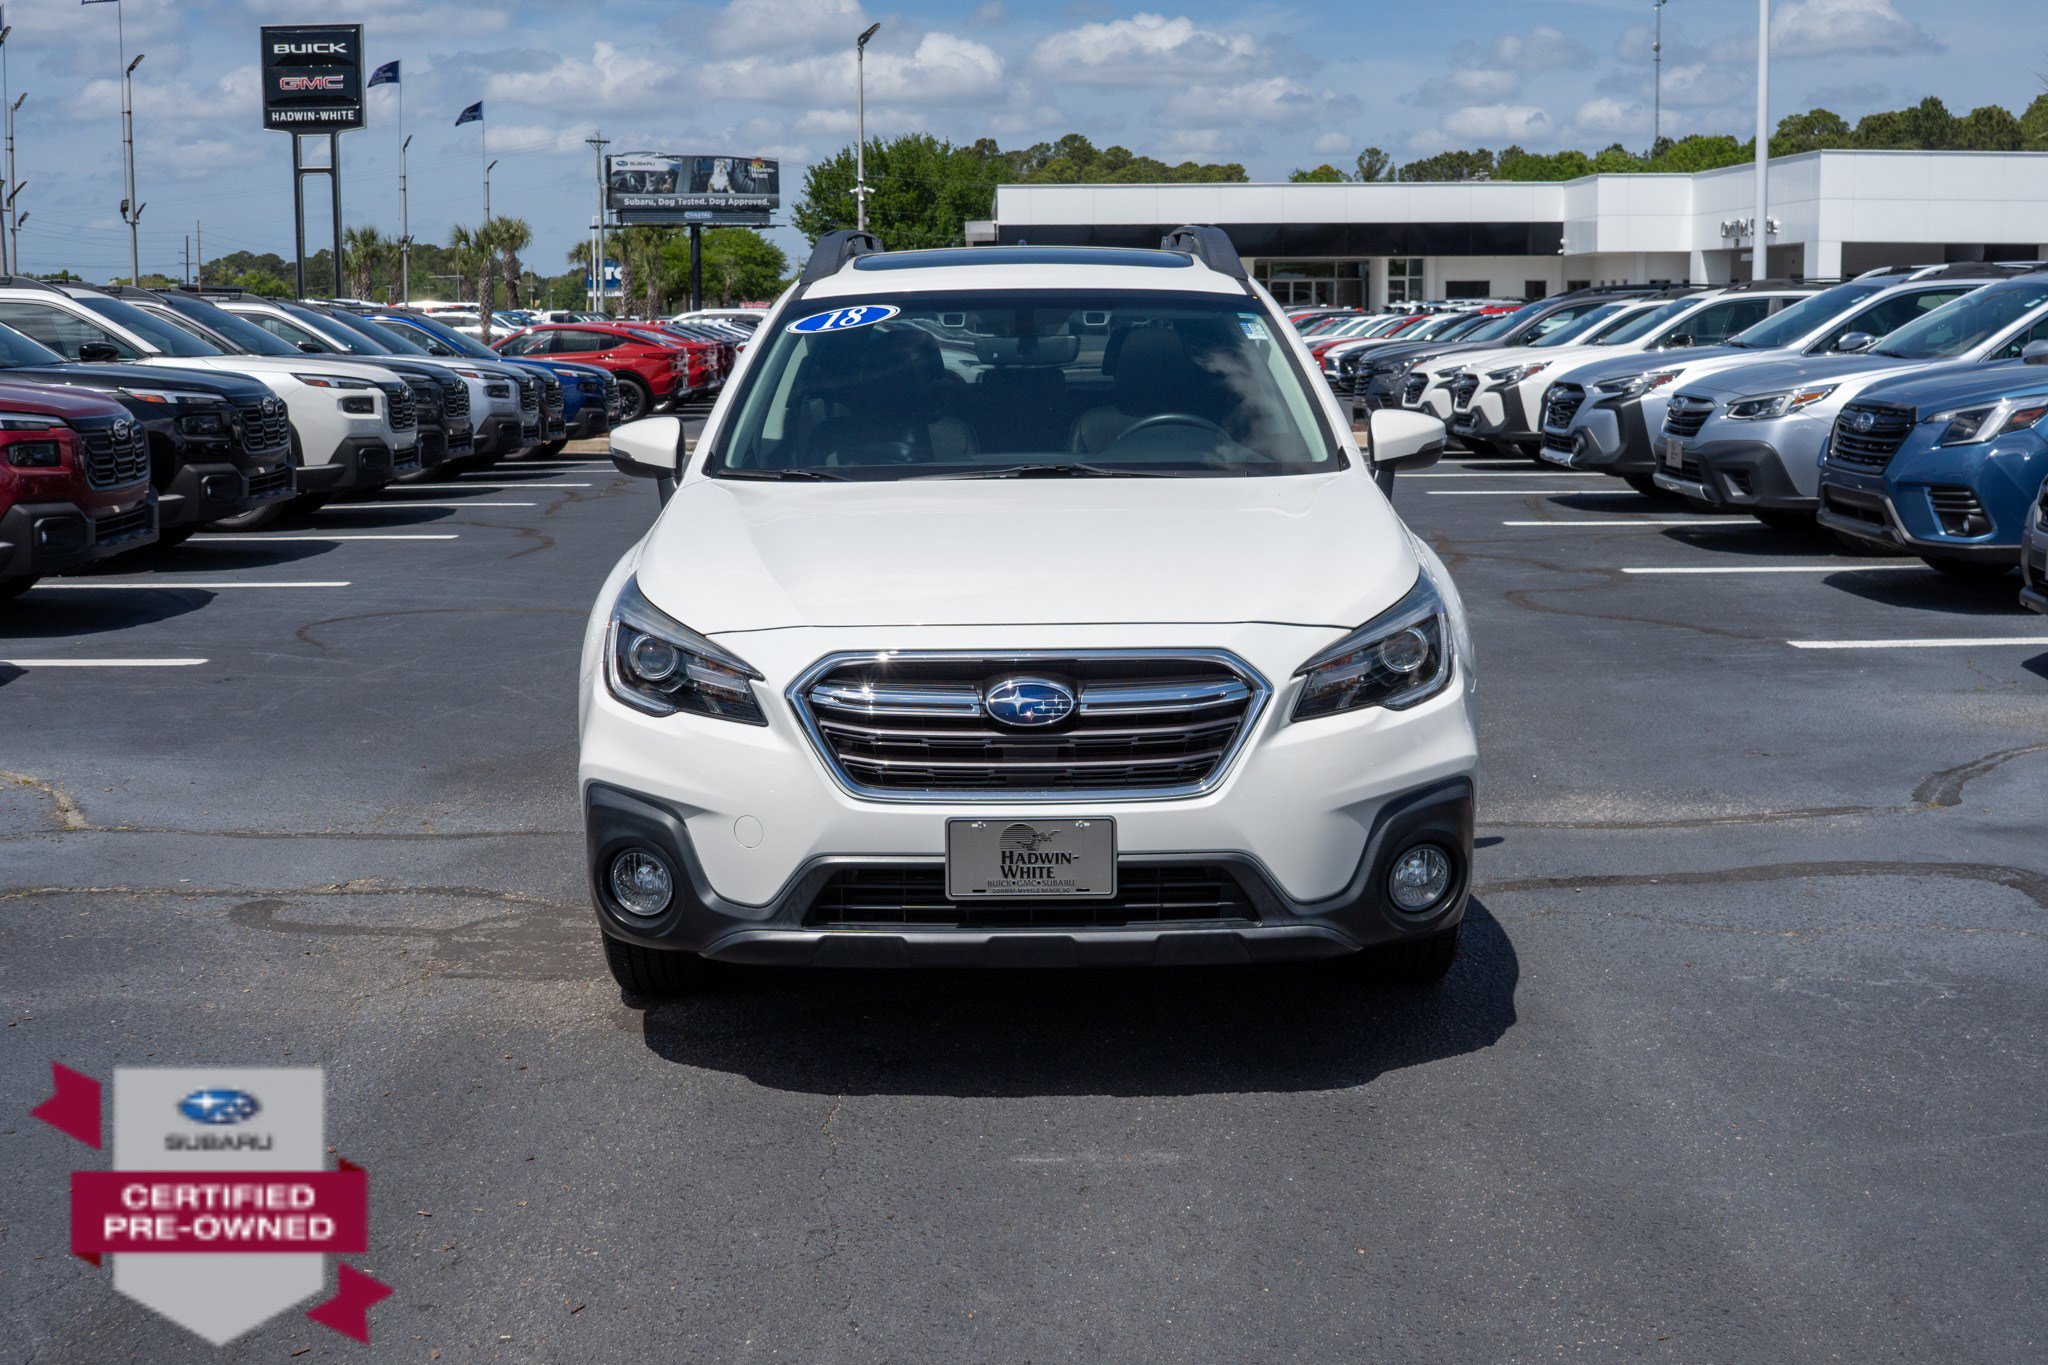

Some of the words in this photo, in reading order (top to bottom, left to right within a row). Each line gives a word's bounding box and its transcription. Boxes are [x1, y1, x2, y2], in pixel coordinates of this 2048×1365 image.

[273, 43, 348, 54] BUICK
[280, 76, 344, 91] GMC
[271, 111, 355, 122] HADWIN-WHITE
[623, 197, 657, 207] Subaru,
[657, 198, 676, 207] Dog
[676, 197, 708, 206] Tested.
[708, 197, 726, 207] Dog
[727, 197, 770, 207] Approved.
[816, 307, 868, 331] 18
[1001, 850, 1080, 865] HADWIN-
[1000, 865, 1056, 879] WHITE
